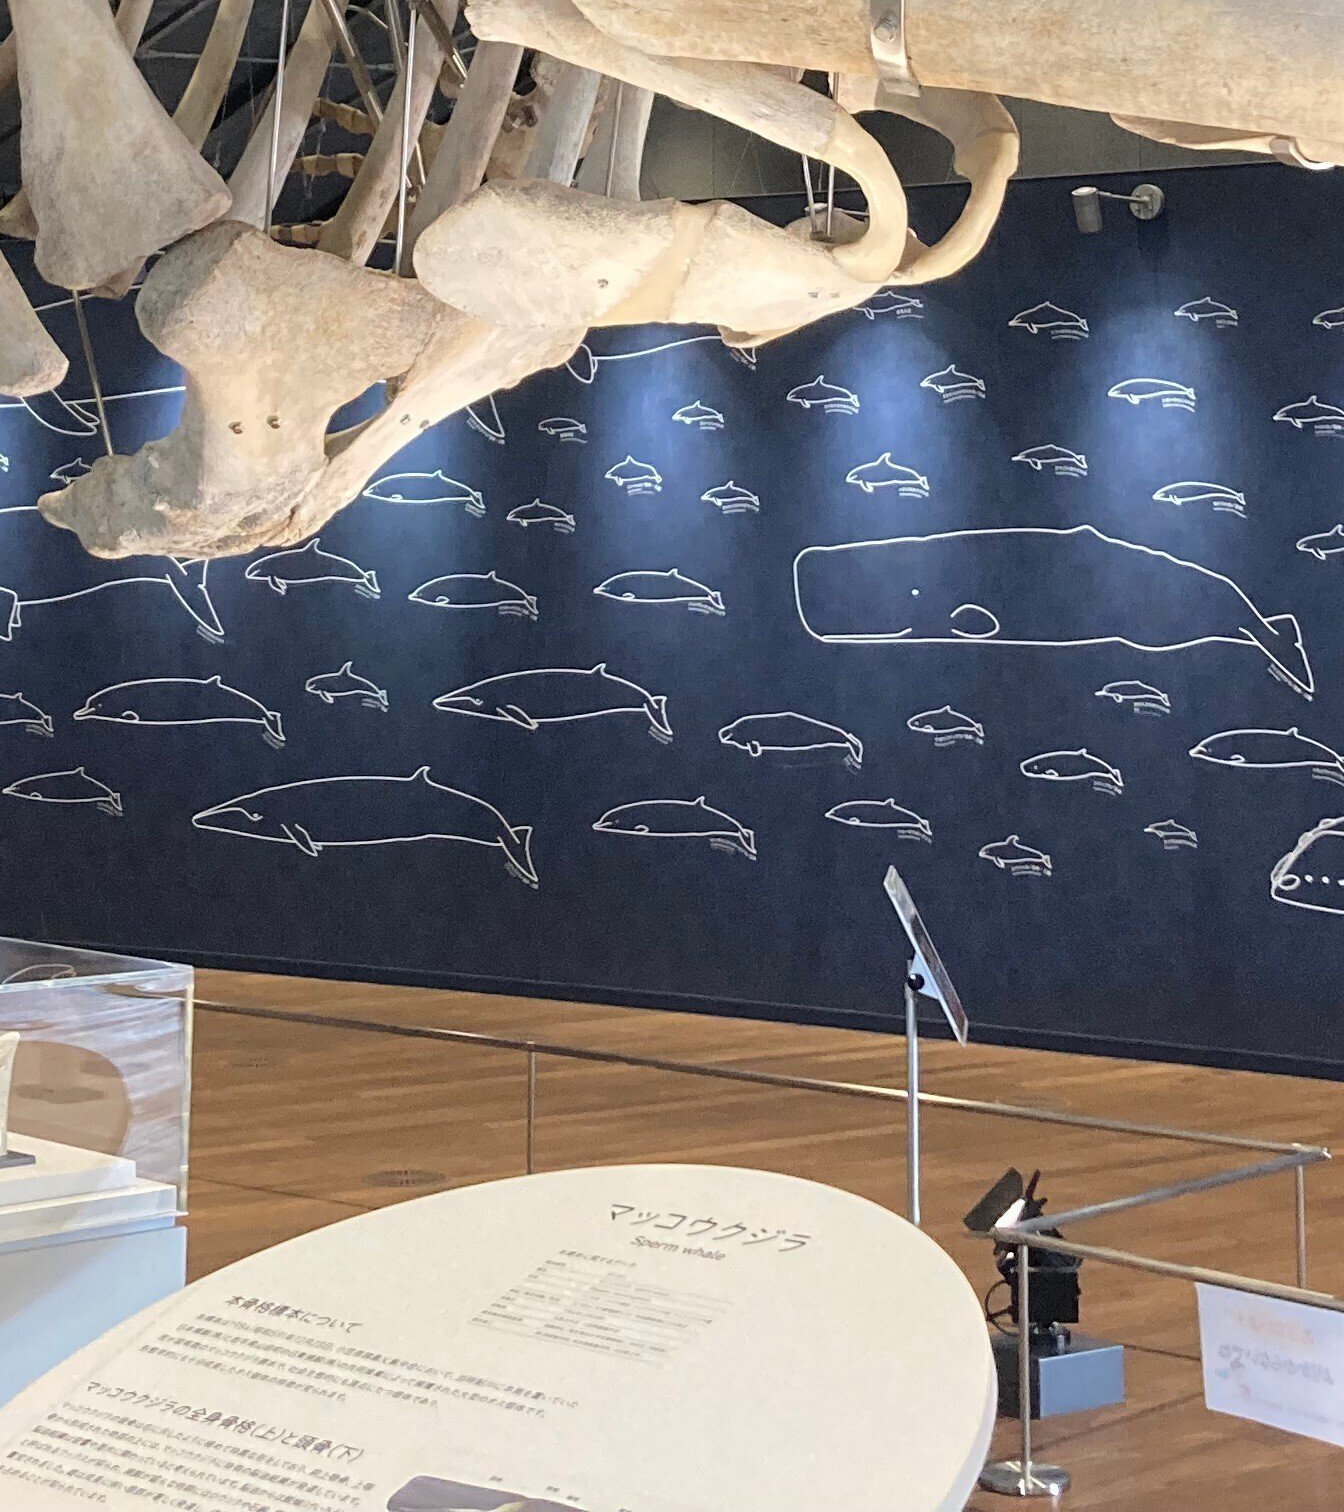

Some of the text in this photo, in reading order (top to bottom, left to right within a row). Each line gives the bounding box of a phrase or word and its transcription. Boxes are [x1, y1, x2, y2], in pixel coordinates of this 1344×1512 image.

[610, 1203, 812, 1253] マッコウクジラ
[630, 1235, 726, 1261] Sperm whale
[225, 1294, 363, 1334] 本骨格標本について
